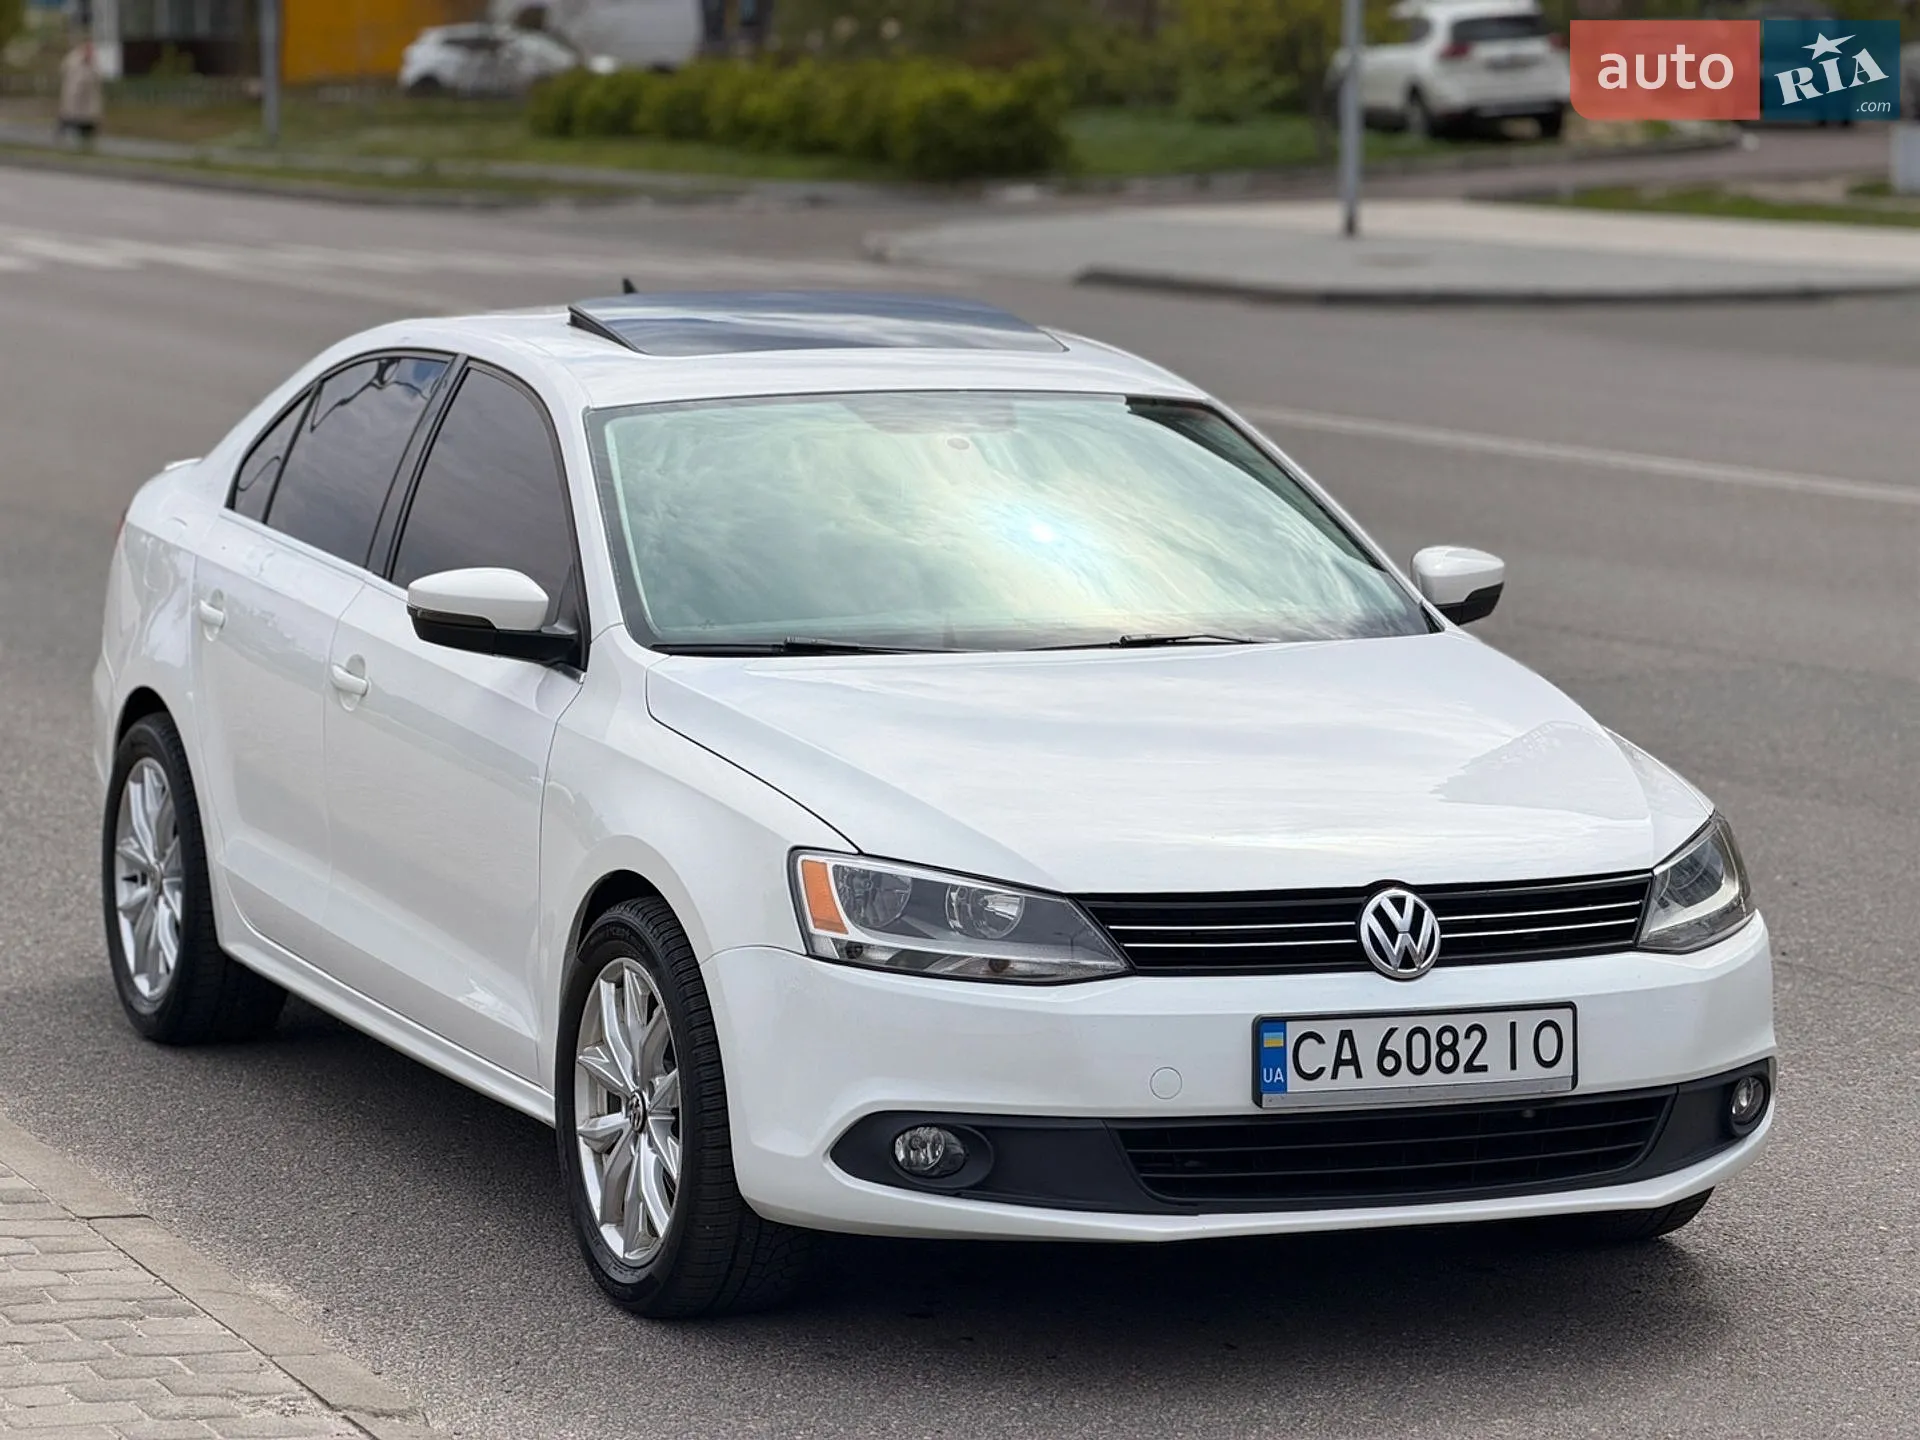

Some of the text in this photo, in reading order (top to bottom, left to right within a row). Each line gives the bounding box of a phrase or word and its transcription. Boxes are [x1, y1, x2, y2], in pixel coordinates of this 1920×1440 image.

[1292, 1029, 1363, 1081] CA
[1376, 1023, 1489, 1077] 6082
[1262, 1067, 1285, 1084] UA
